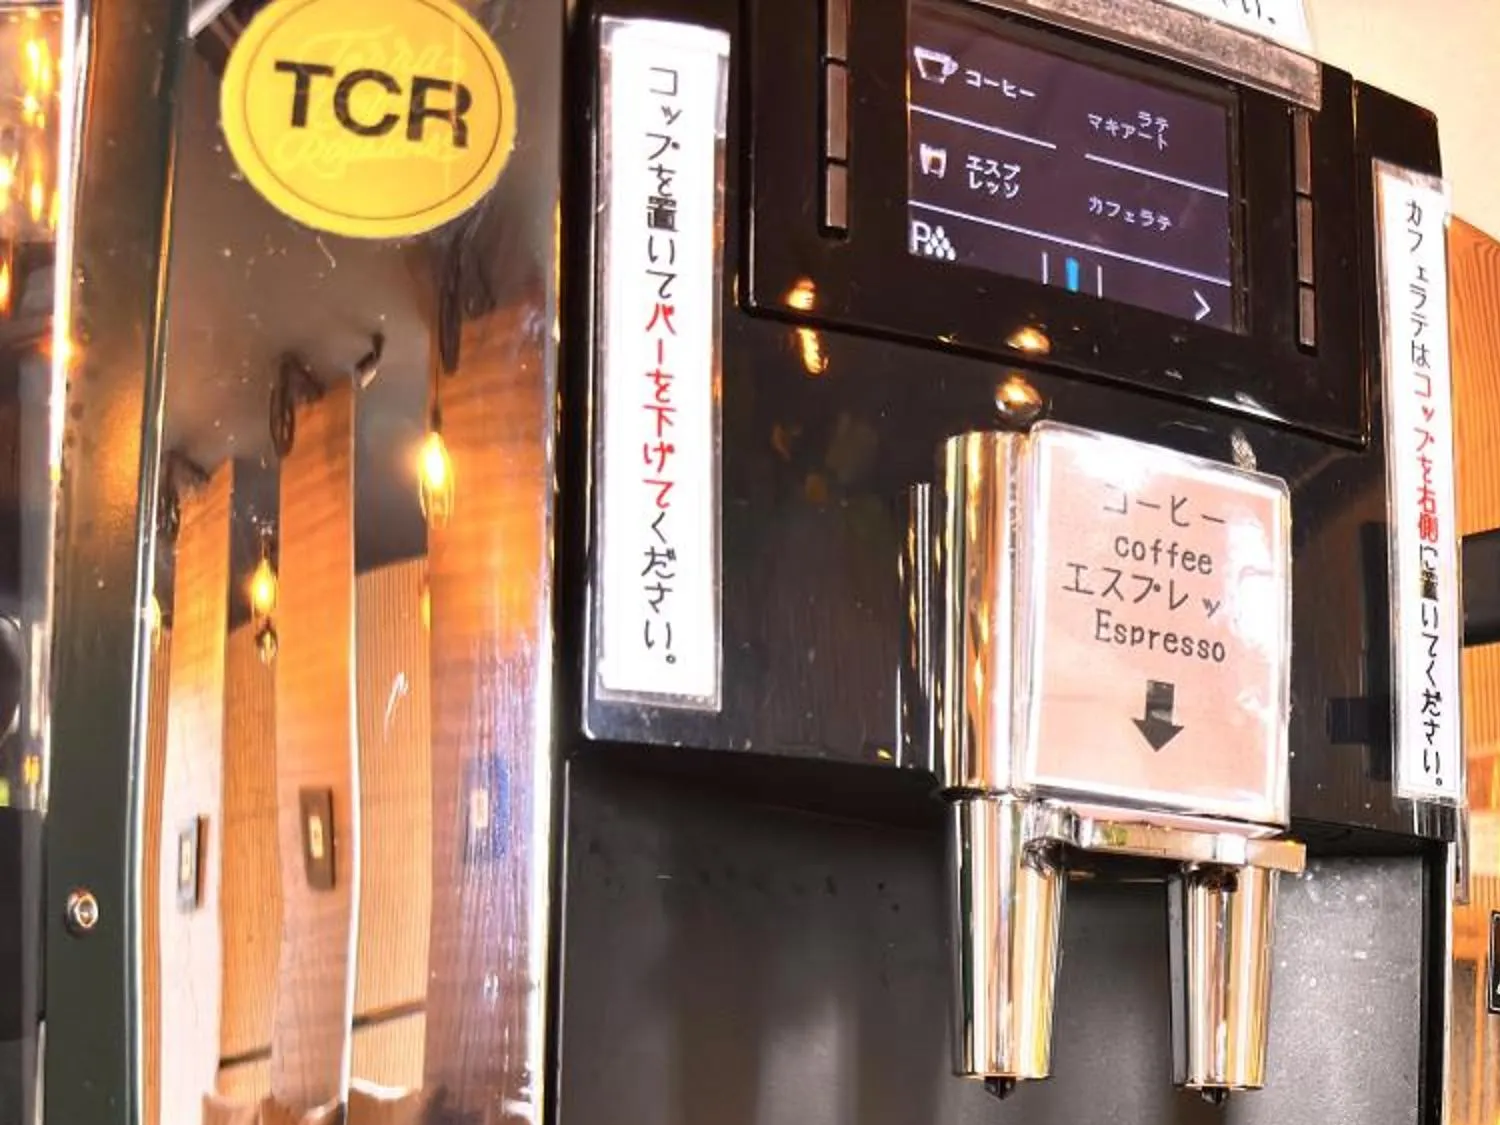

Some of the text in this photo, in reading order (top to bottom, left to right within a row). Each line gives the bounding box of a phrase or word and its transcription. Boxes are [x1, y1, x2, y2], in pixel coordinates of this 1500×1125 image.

[274, 60, 472, 148] TCR
[965, 69, 1036, 98] コーヒー
[1088, 196, 1172, 231] カフェラテ
[1102, 482, 1226, 528] コーヒー
[1115, 535, 1213, 576] coffee
[1062, 562, 1222, 618] エスプレッ
[1095, 608, 1227, 664] Espresso
